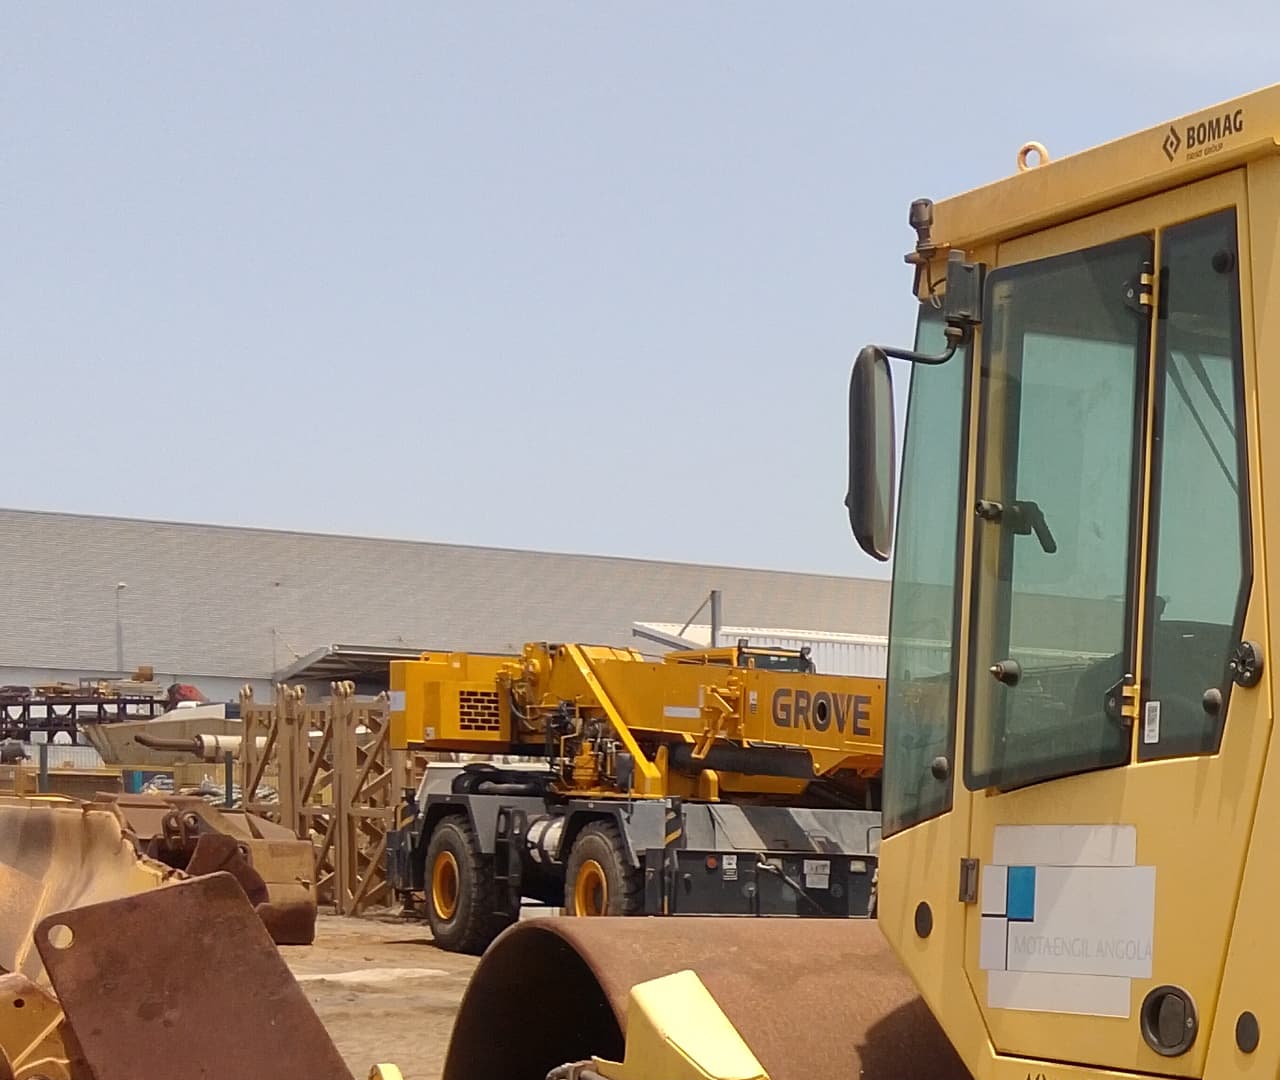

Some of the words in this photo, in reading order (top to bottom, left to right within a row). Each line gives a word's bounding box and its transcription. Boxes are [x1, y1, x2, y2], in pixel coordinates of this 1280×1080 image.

[1186, 109, 1244, 149] BOMAG
[772, 687, 872, 736] GROVE
[1095, 937, 1152, 961] ANGOLA
